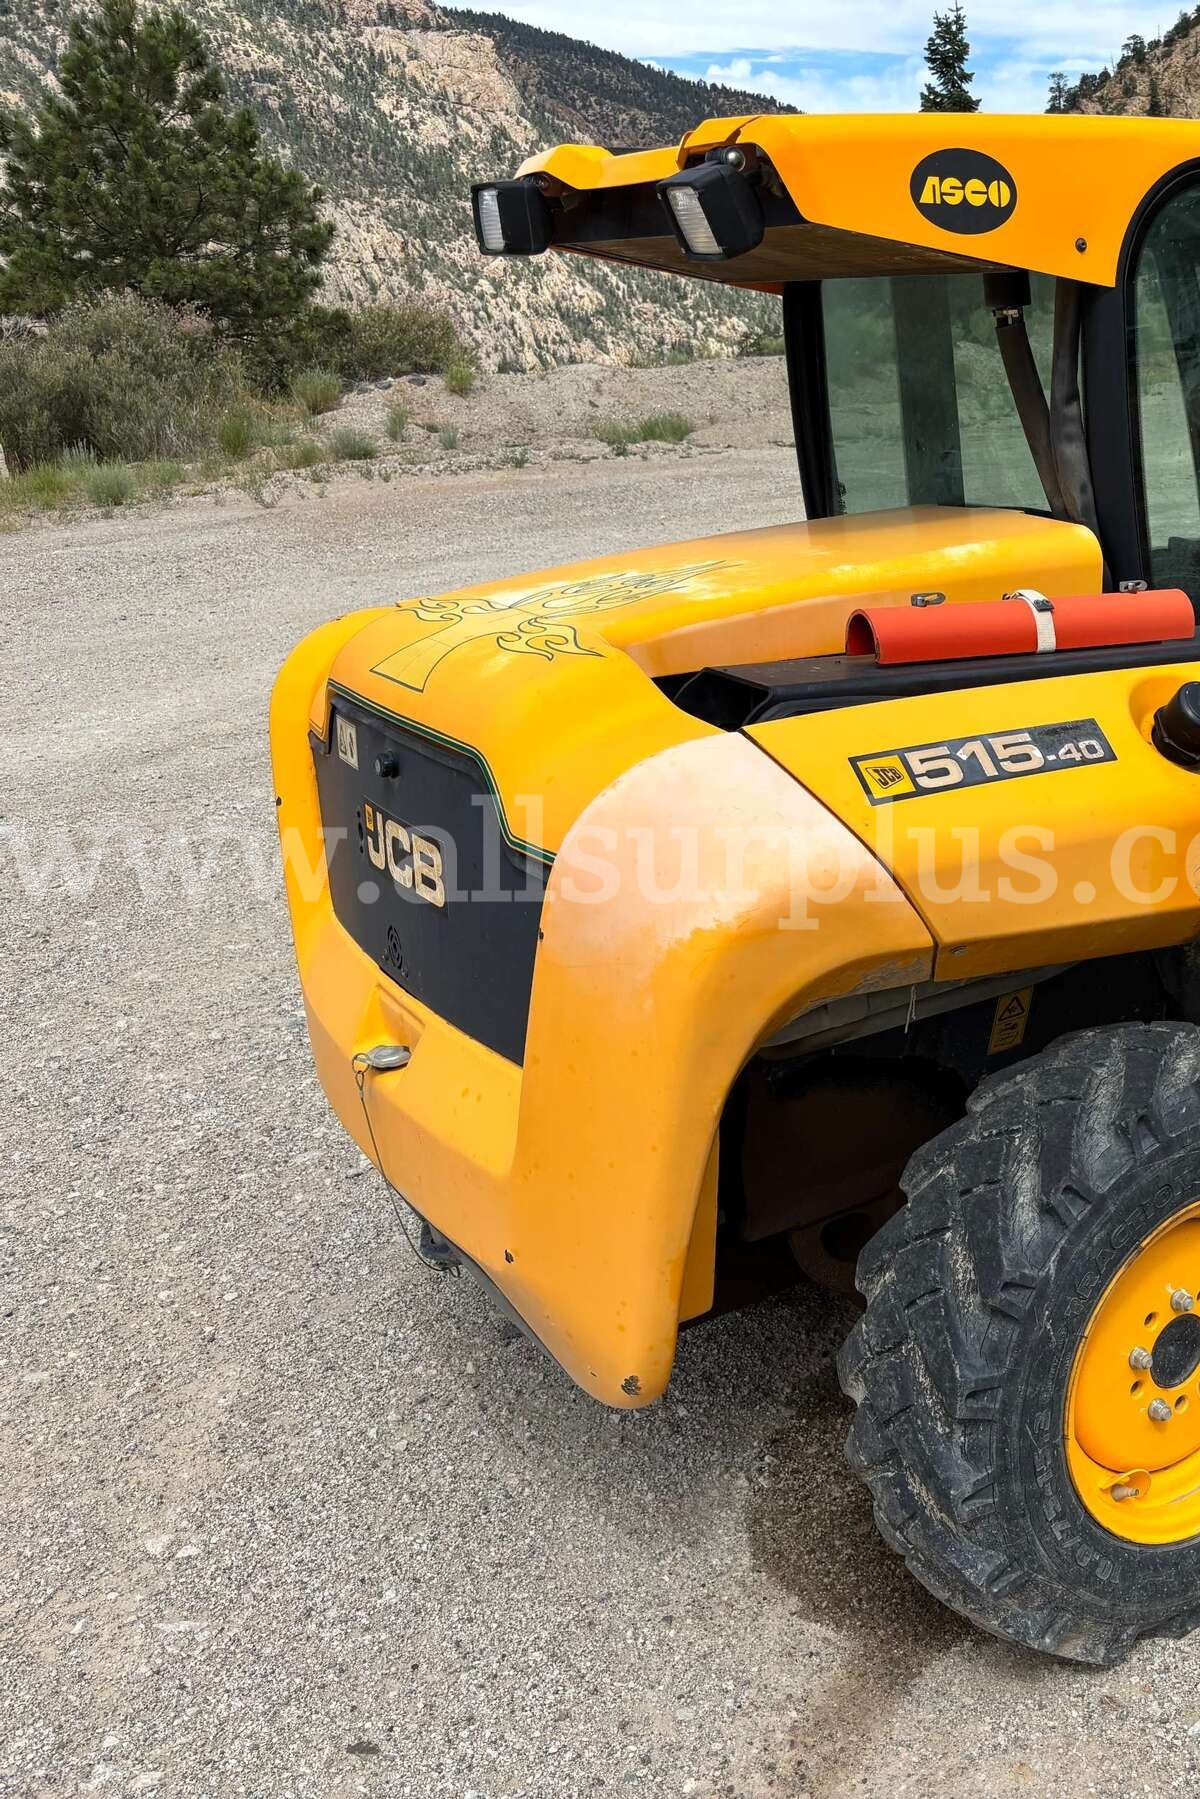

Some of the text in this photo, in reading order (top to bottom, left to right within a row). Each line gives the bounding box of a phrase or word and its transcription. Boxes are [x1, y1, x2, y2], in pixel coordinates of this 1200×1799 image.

[919, 175, 1011, 208] ASCO
[873, 767, 903, 788] JCB
[367, 810, 445, 908] JCB
